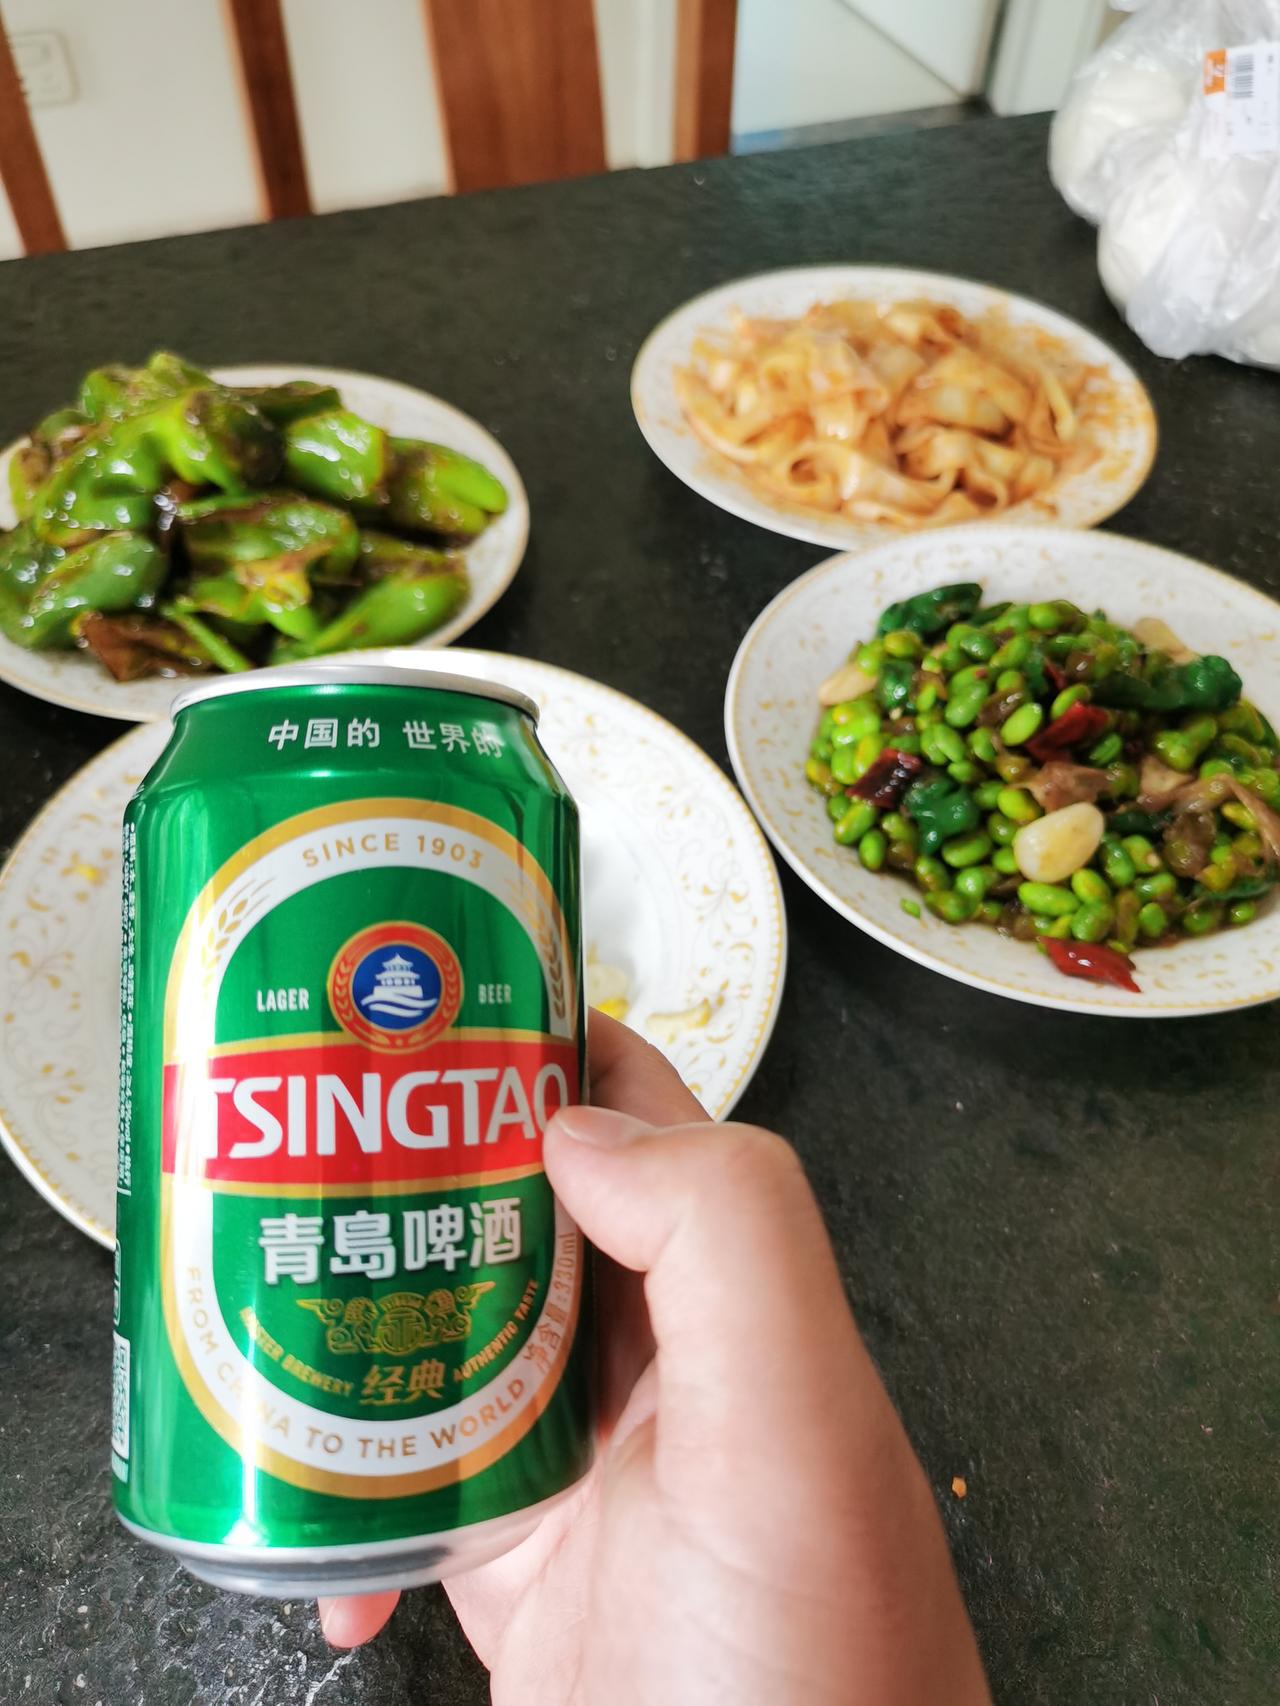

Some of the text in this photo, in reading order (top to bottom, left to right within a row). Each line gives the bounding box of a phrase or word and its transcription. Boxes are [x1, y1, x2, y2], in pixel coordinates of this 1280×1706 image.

[268, 718, 506, 758] 中国的 世界的
[302, 832, 485, 869] SINCE 1903
[256, 983, 512, 1013] LAGER BEER
[184, 1063, 568, 1160] TSINGTAO
[453, 1278, 539, 1383] AUTHENTIC TASTE
[187, 1266, 220, 1355] FROM
[217, 1361, 291, 1438] CHNA
[306, 1425, 344, 1454] TO
[357, 1435, 417, 1459] THE
[430, 1378, 525, 1449] WORLD
[358, 1358, 446, 1405] 经典
